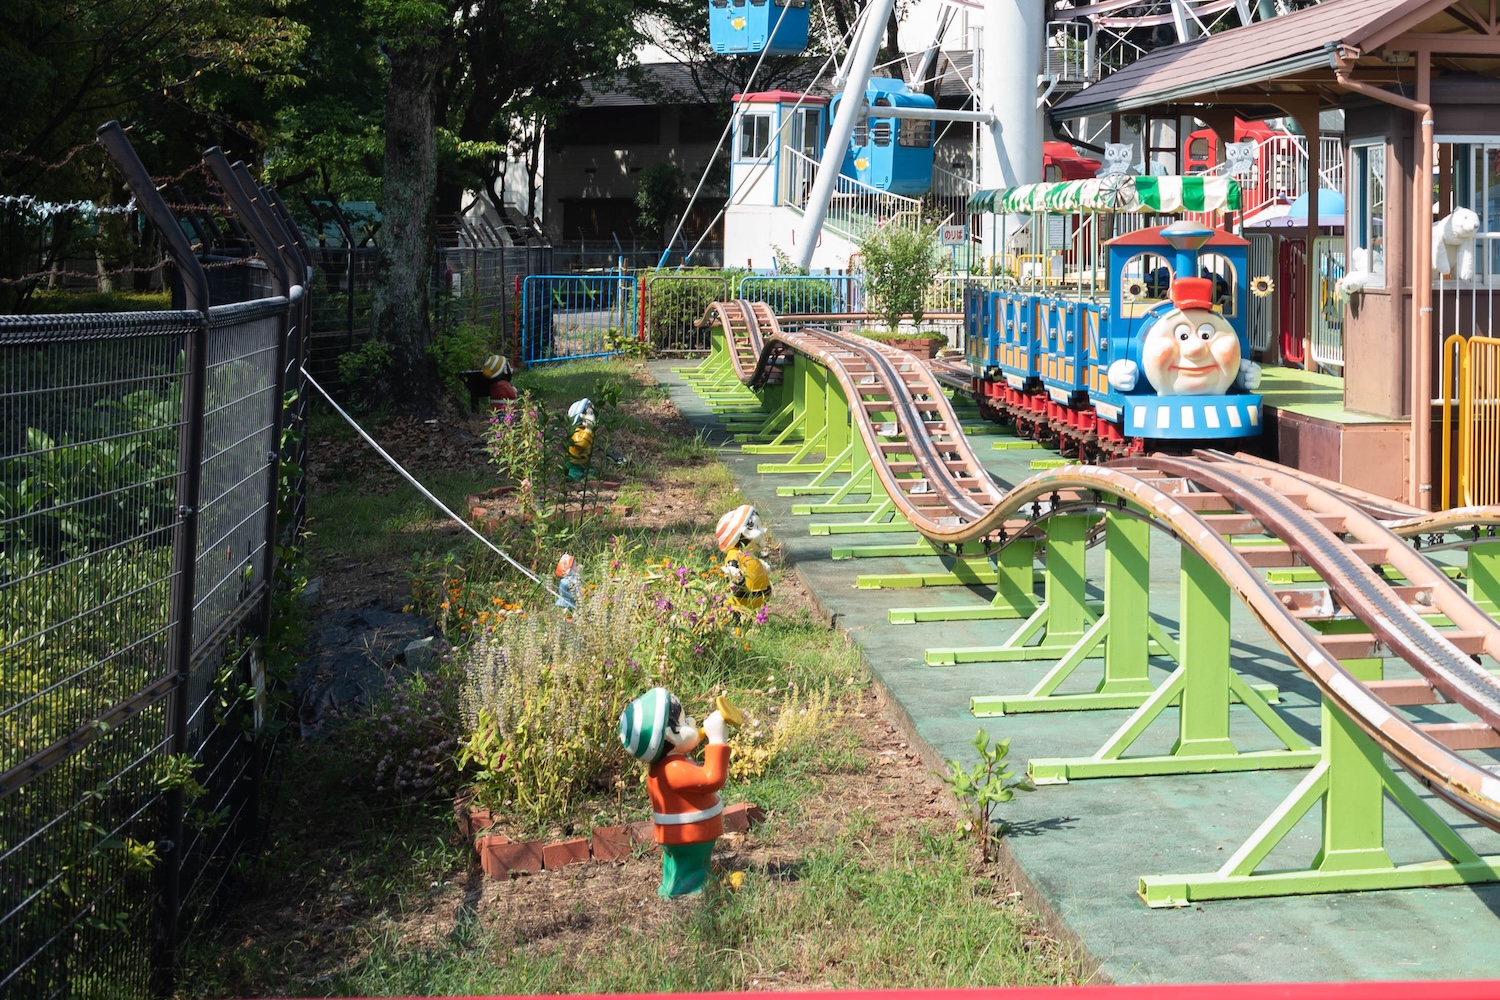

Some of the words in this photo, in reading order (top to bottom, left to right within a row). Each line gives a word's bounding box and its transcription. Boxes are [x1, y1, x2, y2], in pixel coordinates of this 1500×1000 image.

[884, 175, 889, 184] 8
[944, 229, 963, 240] のりば
